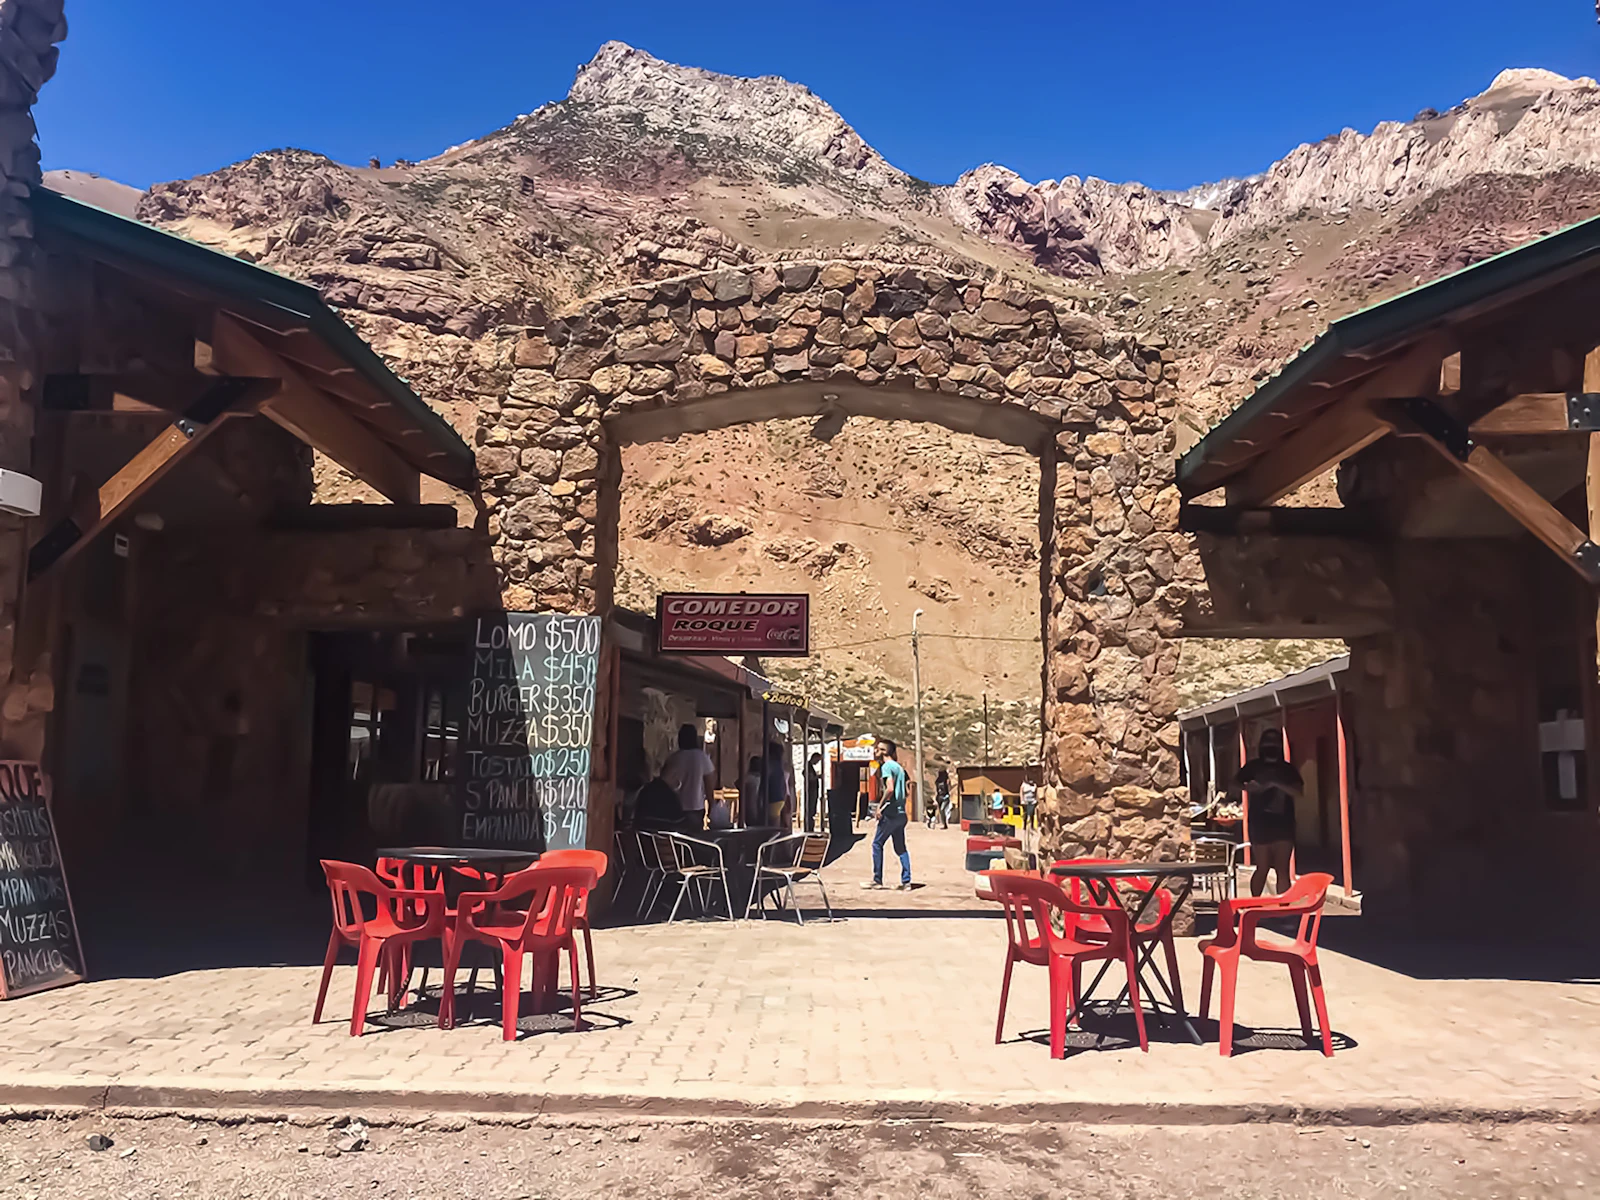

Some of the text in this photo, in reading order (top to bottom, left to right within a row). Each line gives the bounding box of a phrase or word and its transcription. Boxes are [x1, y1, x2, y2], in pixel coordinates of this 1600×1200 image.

[667, 600, 800, 616] COMEDOR
[475, 616, 599, 655] LOMO $500
[672, 619, 760, 632] ROQUE
[473, 652, 597, 687] MILA $450
[467, 678, 594, 717] BURGER $350
[467, 713, 592, 748] MUZZA $350
[466, 748, 590, 778] TOSTADO $250
[544, 776, 587, 810] $120
[462, 812, 540, 841] EMPANADA
[0, 875, 65, 909] MPANADAS
